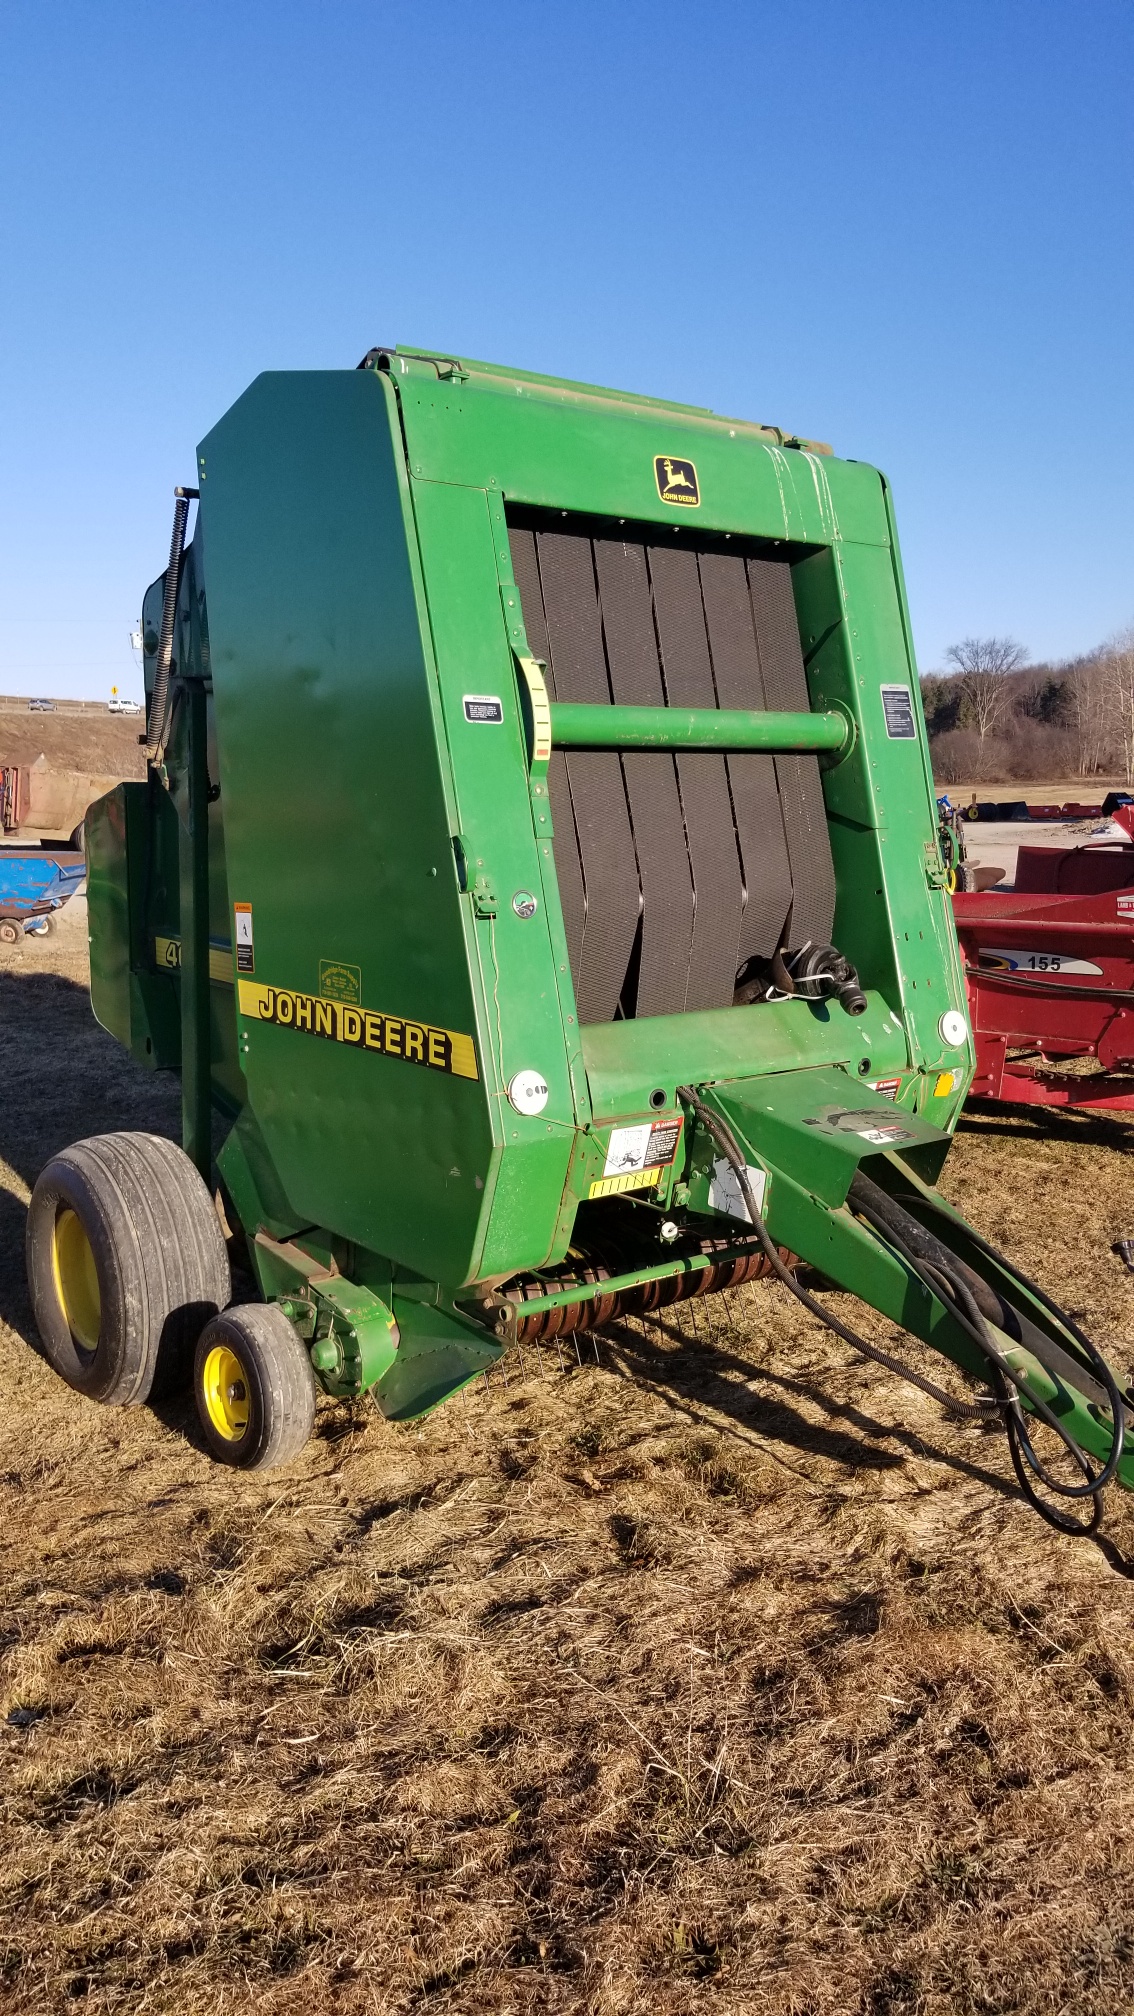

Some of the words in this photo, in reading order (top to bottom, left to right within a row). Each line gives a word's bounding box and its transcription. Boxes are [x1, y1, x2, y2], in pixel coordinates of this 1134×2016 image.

[663, 492, 678, 501] JOHN
[678, 495, 698, 504] DEERE
[166, 942, 182, 969] 4
[1028, 956, 1062, 971] 155
[259, 989, 333, 1036] JOHN
[343, 1007, 447, 1068] DEERE
